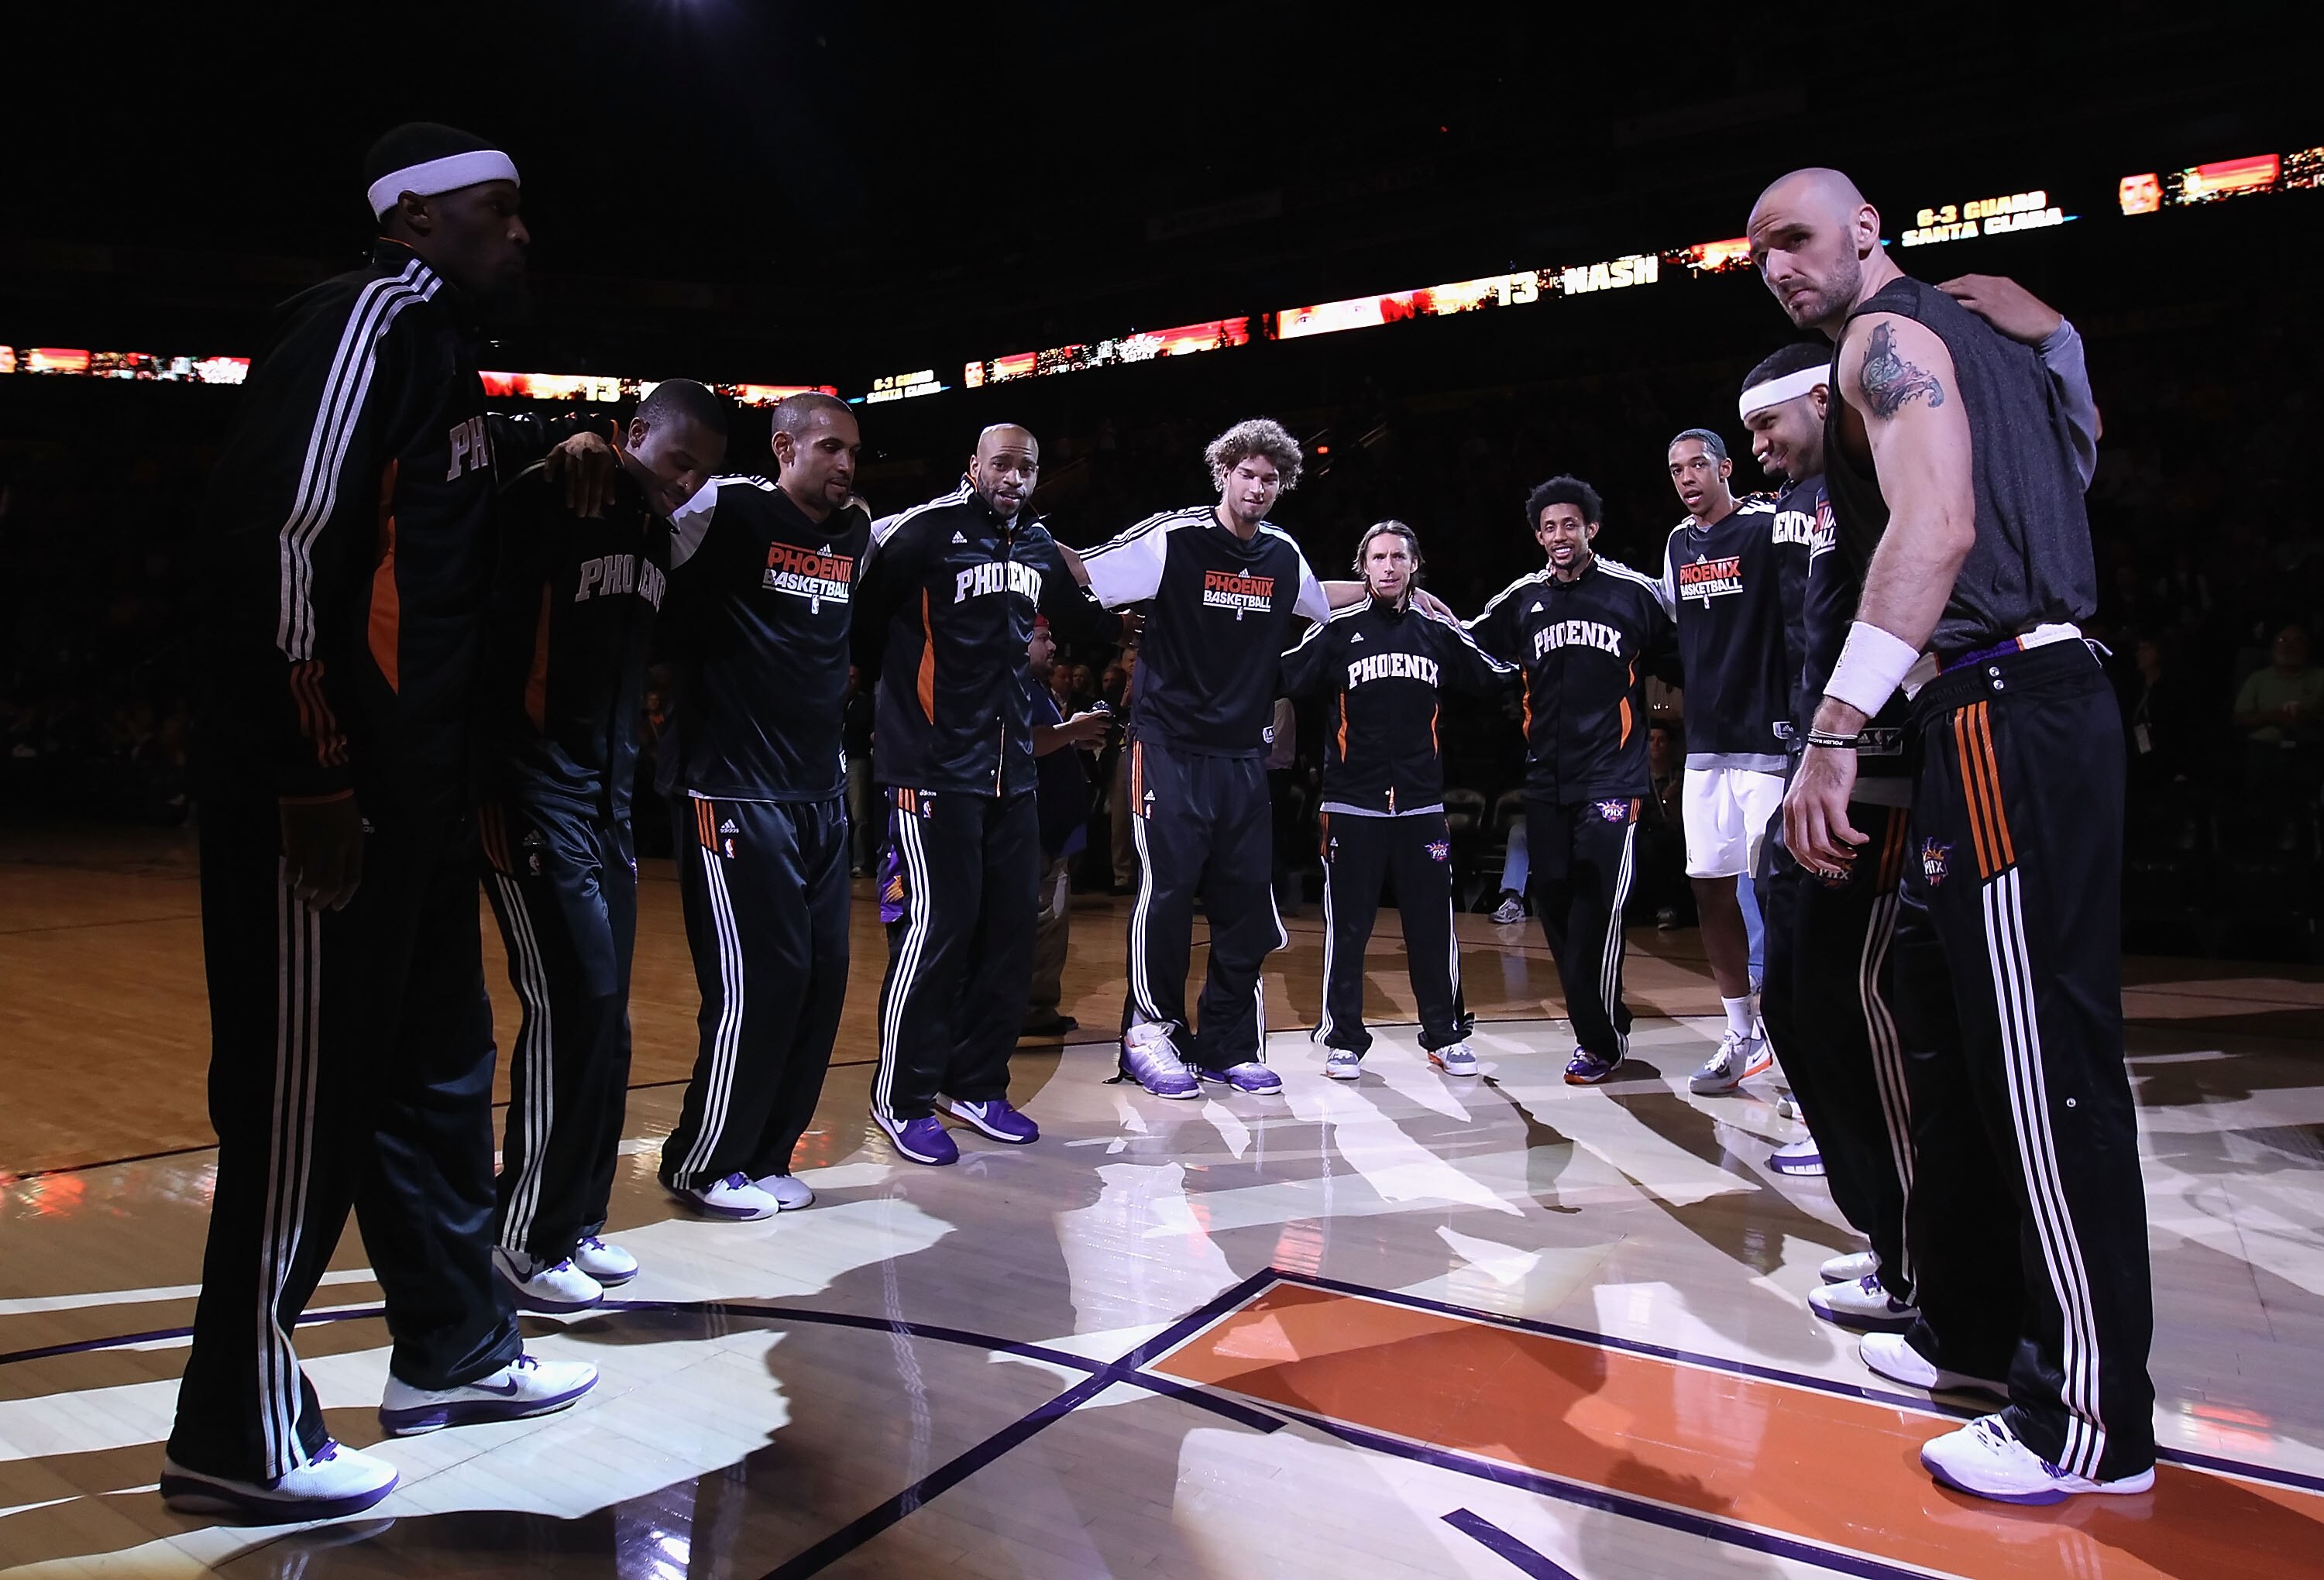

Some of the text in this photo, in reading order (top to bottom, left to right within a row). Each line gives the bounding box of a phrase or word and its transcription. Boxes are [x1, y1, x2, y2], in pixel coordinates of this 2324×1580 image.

[1917, 191, 2047, 227] 6-3 GUARD
[1902, 208, 2064, 247] SANTA CLARA
[1564, 256, 1659, 295] NASH
[768, 547, 853, 582] PHOENIX
[1679, 559, 1741, 584] PHOENIX
[762, 568, 850, 599] BASKETBALL
[1203, 589, 1271, 609] BASKETBALL
[1205, 574, 1274, 597] PHOENIX
[1679, 576, 1743, 597] BASKETBALL
[1533, 620, 1621, 660] PHOENIX
[1347, 652, 1439, 690] PHOENIX
[1604, 808, 1624, 817] PHX
